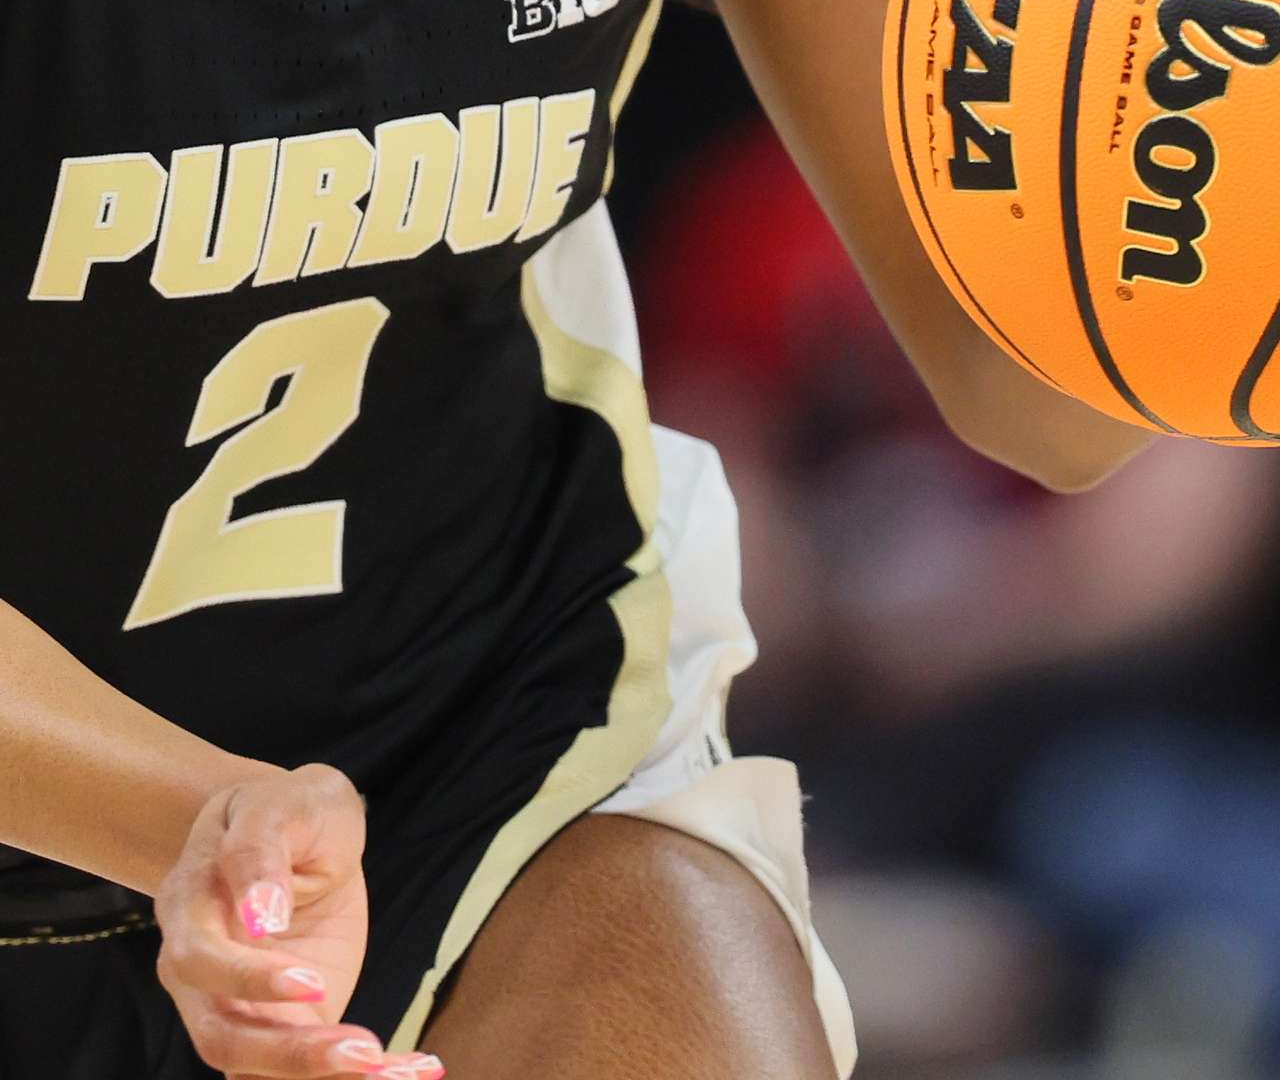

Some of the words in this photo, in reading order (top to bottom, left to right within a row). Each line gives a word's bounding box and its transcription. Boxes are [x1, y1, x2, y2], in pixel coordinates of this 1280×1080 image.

[1120, 16, 1141, 84] GAME
[925, 93, 939, 188] BALL
[1108, 95, 1128, 154] BALL
[28, 89, 596, 301] PURDUE
[122, 296, 392, 631] 2
